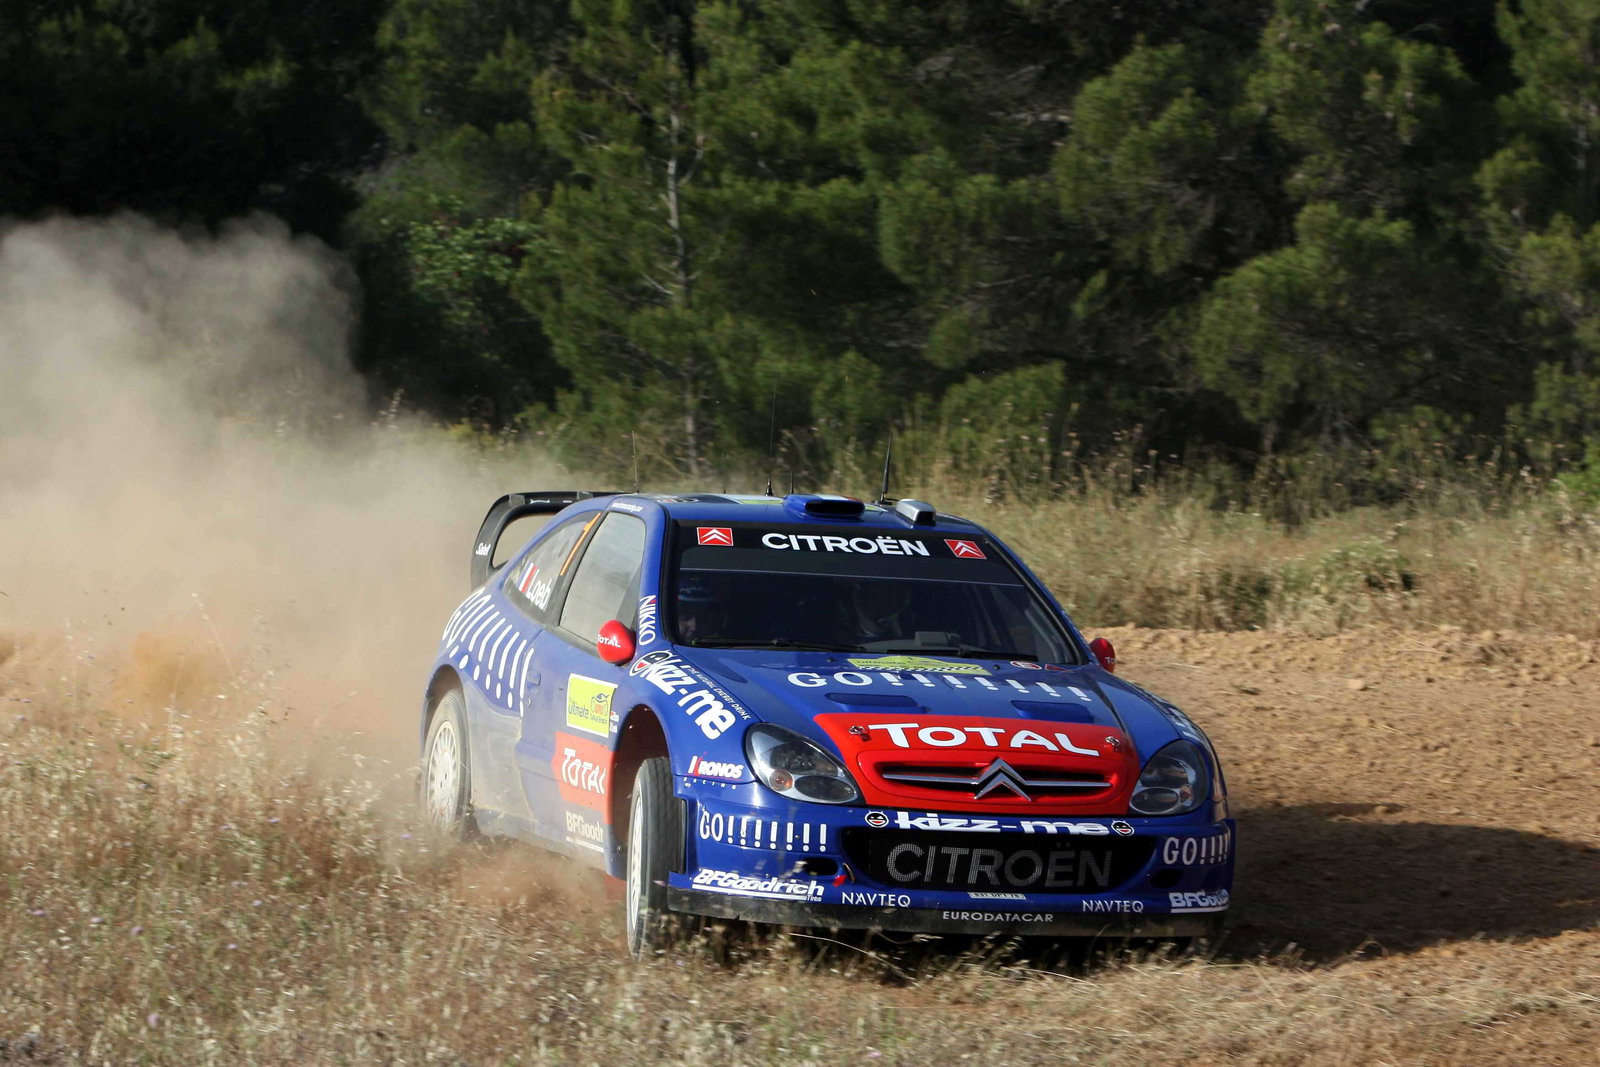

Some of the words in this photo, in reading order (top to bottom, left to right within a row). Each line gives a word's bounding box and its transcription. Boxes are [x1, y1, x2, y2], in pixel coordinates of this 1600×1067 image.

[761, 532, 931, 556] CITROËN
[526, 568, 553, 612] Loeb
[639, 595, 657, 646] NIKKO
[597, 633, 621, 648] TOTAL
[731, 703, 752, 720] DRINK
[868, 722, 1100, 757] TOTAL
[894, 811, 1111, 836] kizz-me
[886, 841, 1112, 887] CITROËN
[692, 868, 825, 896] BFGoodrich
[841, 891, 911, 909] NAVTEQ
[1082, 899, 1144, 914] NAVTEQ
[942, 910, 1054, 923] EURODATACAR
